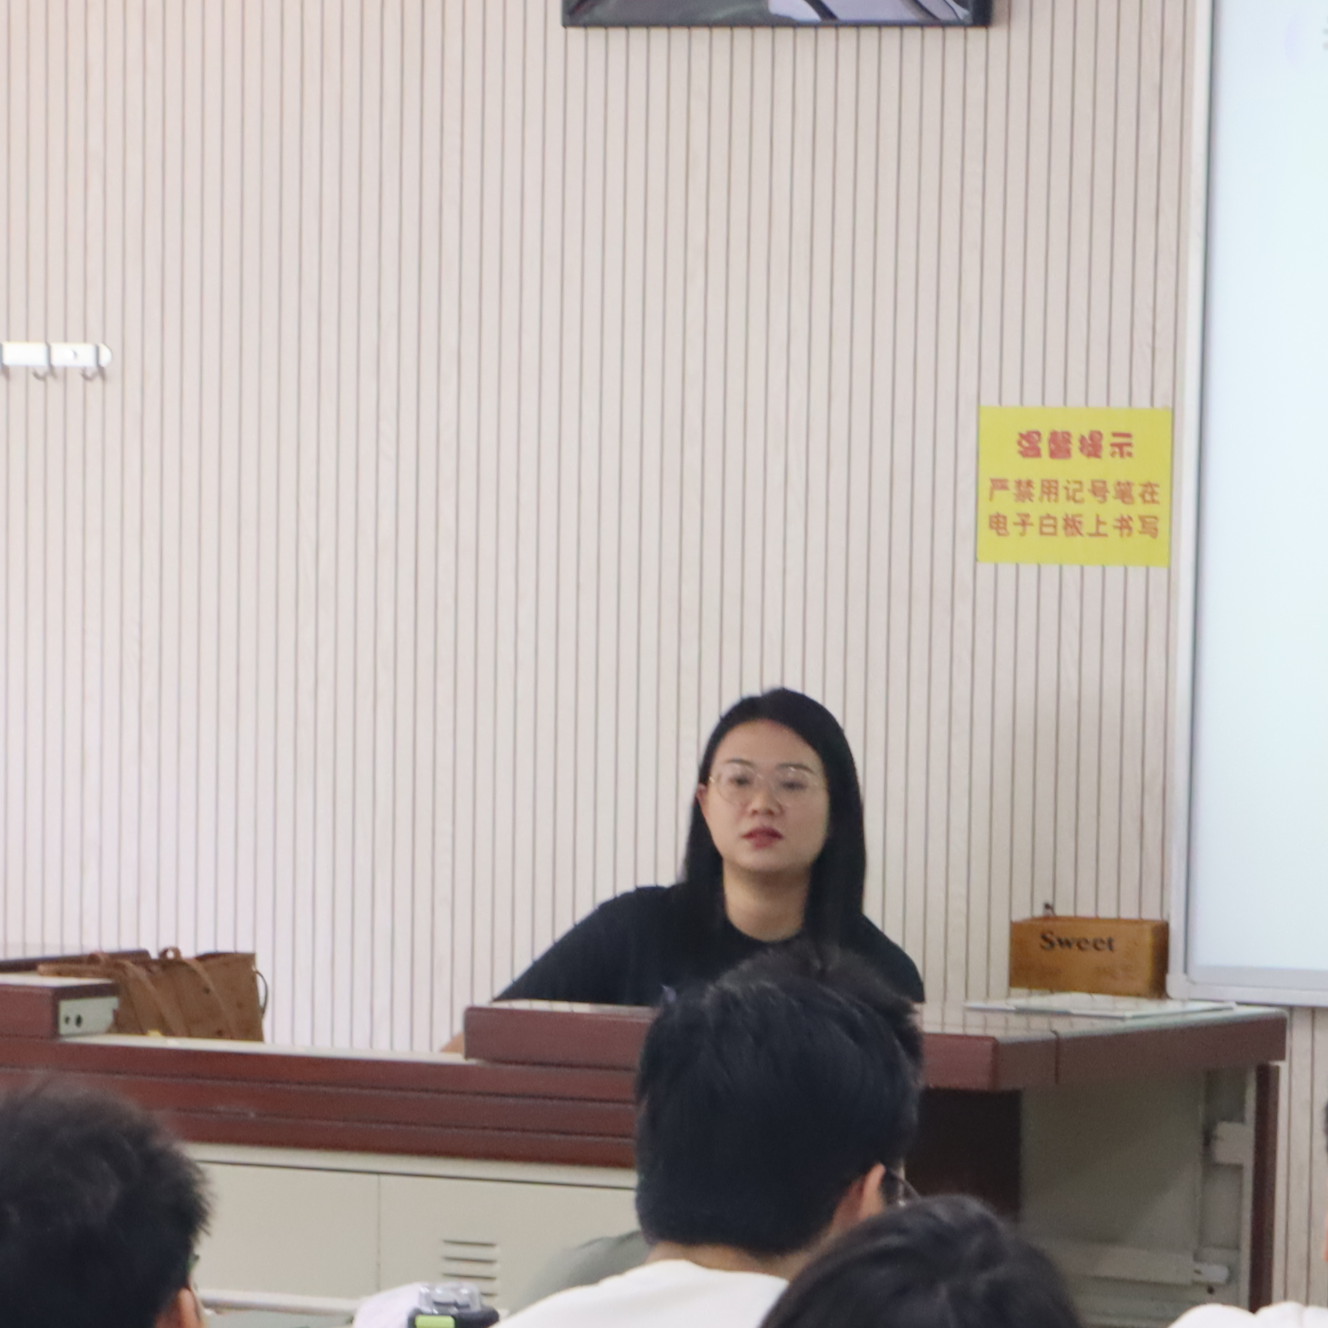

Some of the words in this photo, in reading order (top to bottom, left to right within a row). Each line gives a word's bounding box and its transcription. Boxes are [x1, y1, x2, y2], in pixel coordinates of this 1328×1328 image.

[988, 477, 1161, 505] 严禁用记号笔在
[988, 511, 1160, 539] 电子白板上书写
[1039, 929, 1116, 952] Sweet
